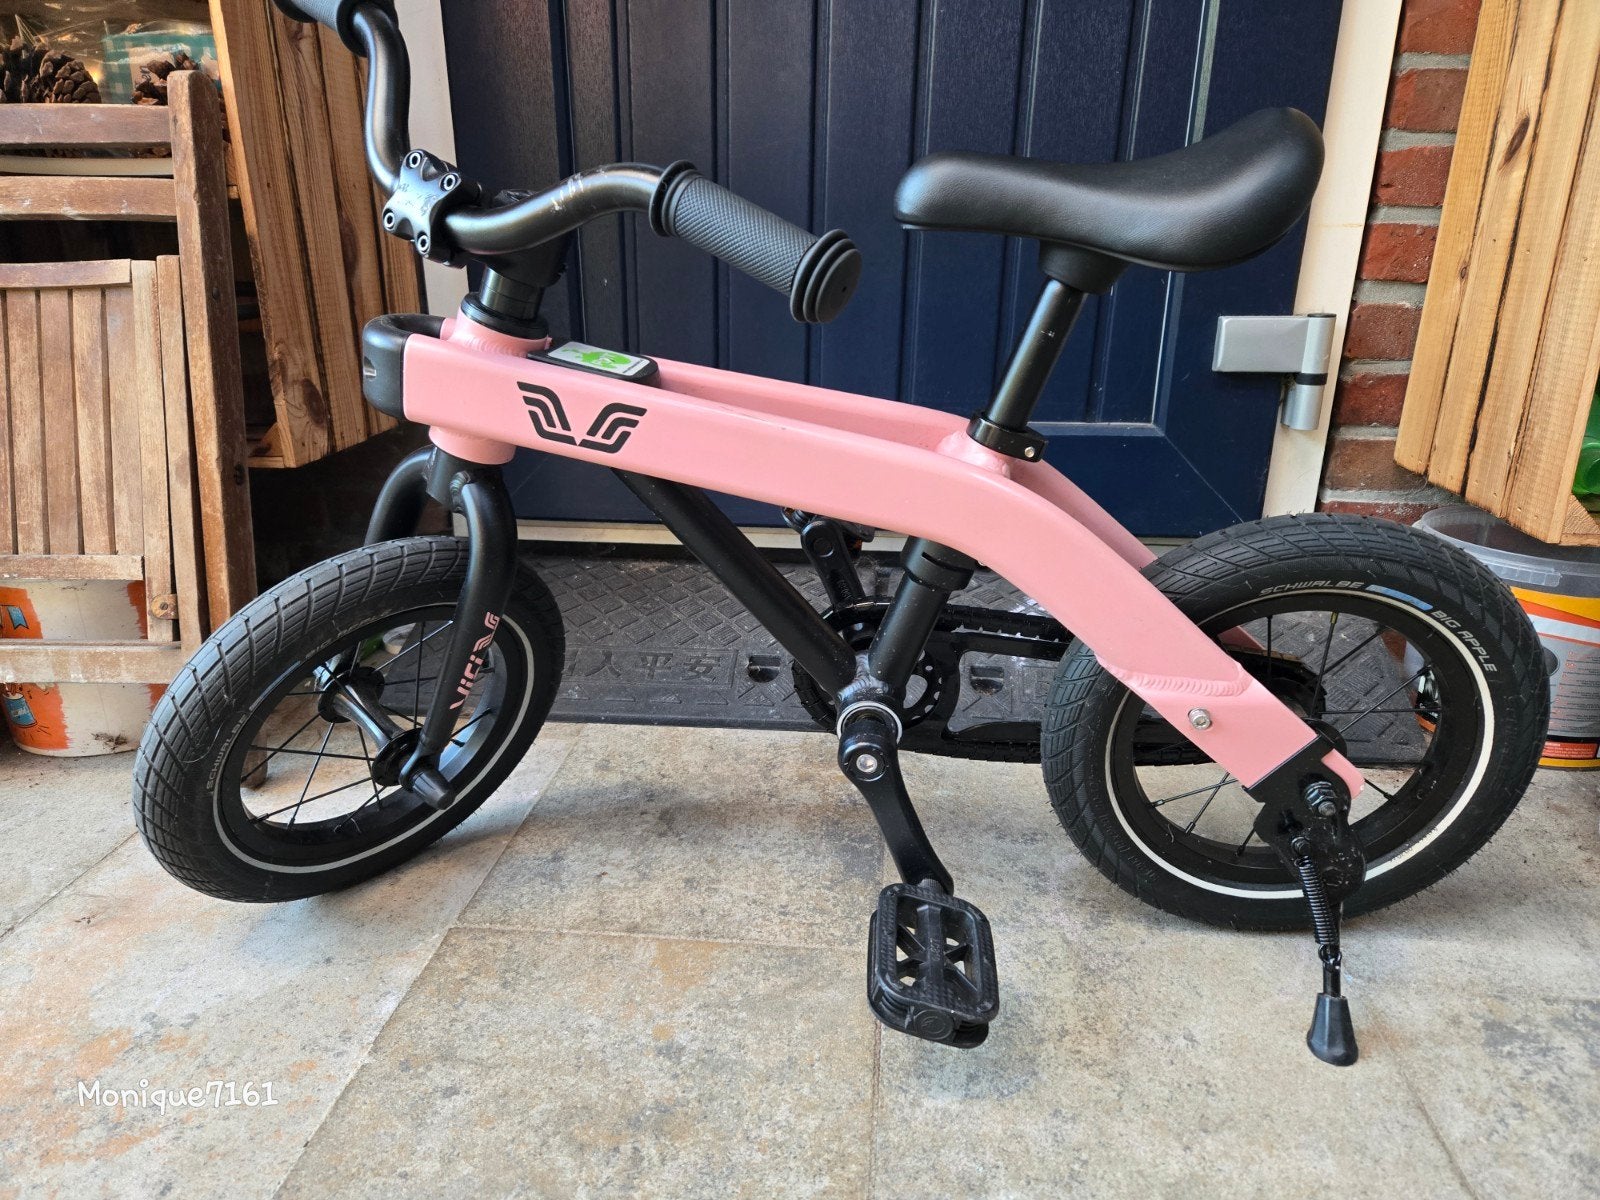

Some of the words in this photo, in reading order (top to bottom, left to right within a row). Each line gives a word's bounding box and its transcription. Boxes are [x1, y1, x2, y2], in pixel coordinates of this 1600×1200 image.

[1260, 580, 1365, 596] SCHWALBE
[1431, 609, 1462, 629] BIG
[1457, 630, 1498, 672] APPLE
[205, 712, 248, 790] SCHWALBE
